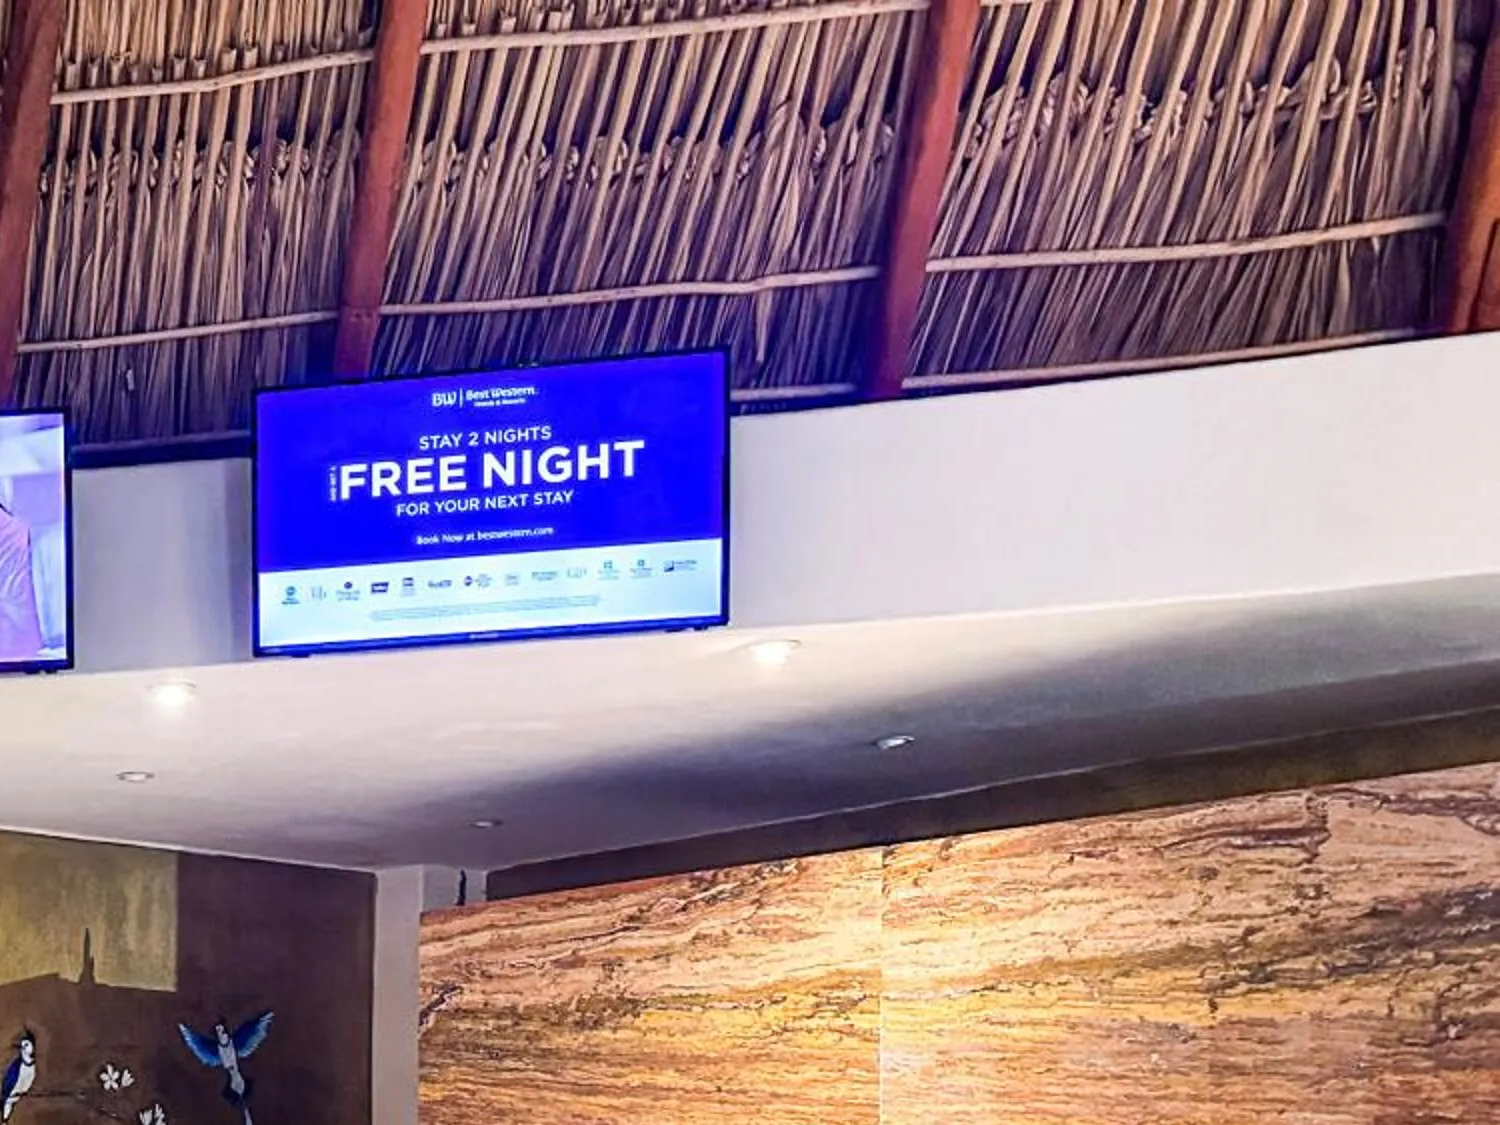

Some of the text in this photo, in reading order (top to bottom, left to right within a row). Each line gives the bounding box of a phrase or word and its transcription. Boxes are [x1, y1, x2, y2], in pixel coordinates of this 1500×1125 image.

[432, 392, 457, 408] BW
[419, 425, 553, 450] STAY 2 NIGHTS
[341, 439, 646, 501] FREE NIGHT
[396, 489, 575, 517] FOR YOUR NEXT STAY
[415, 535, 440, 545] Book
[442, 533, 464, 544] Now
